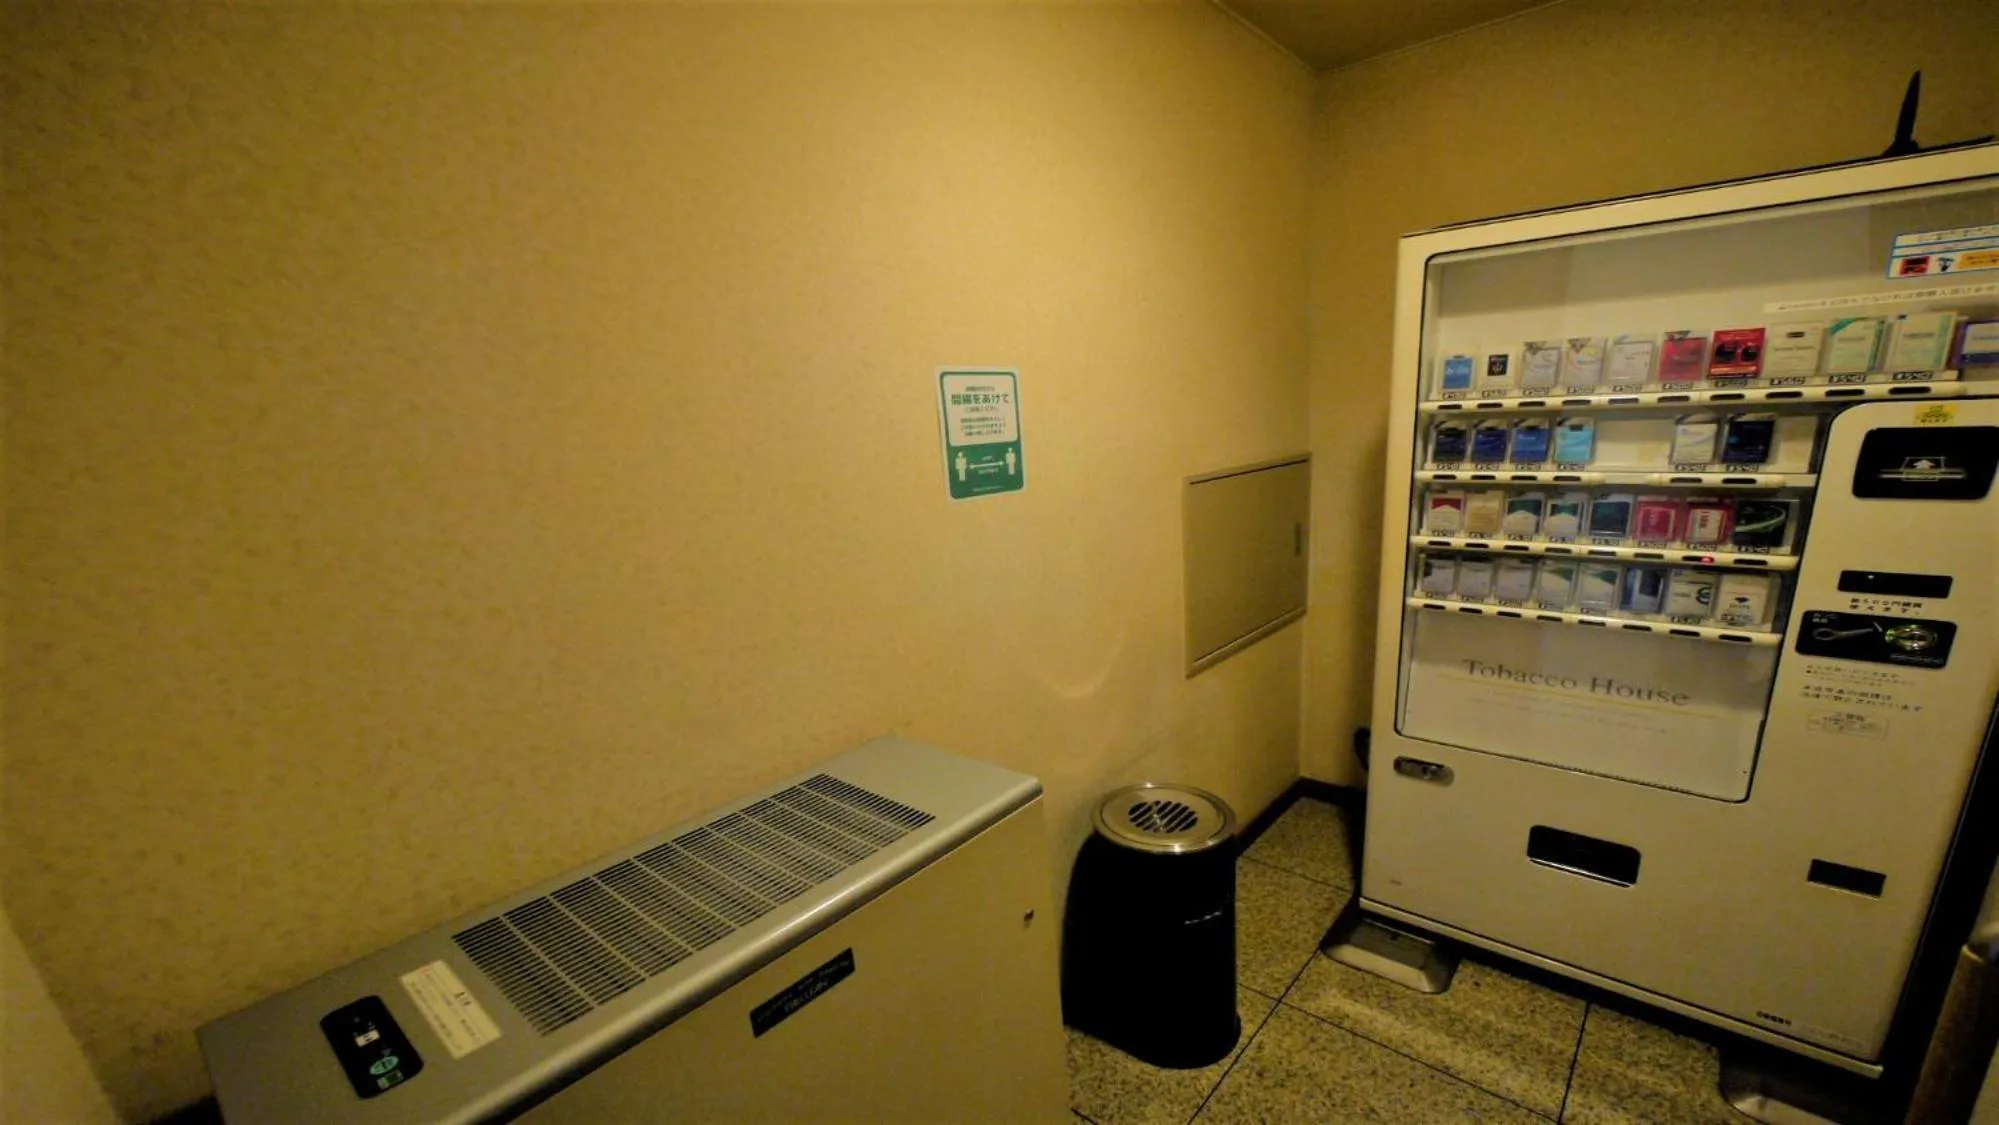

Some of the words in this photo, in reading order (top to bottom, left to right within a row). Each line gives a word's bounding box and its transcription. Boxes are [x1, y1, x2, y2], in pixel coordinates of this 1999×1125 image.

[951, 393, 1010, 406] 間隔をあけて
[1462, 658, 1578, 690] Tobacco
[1588, 676, 1692, 706] House
